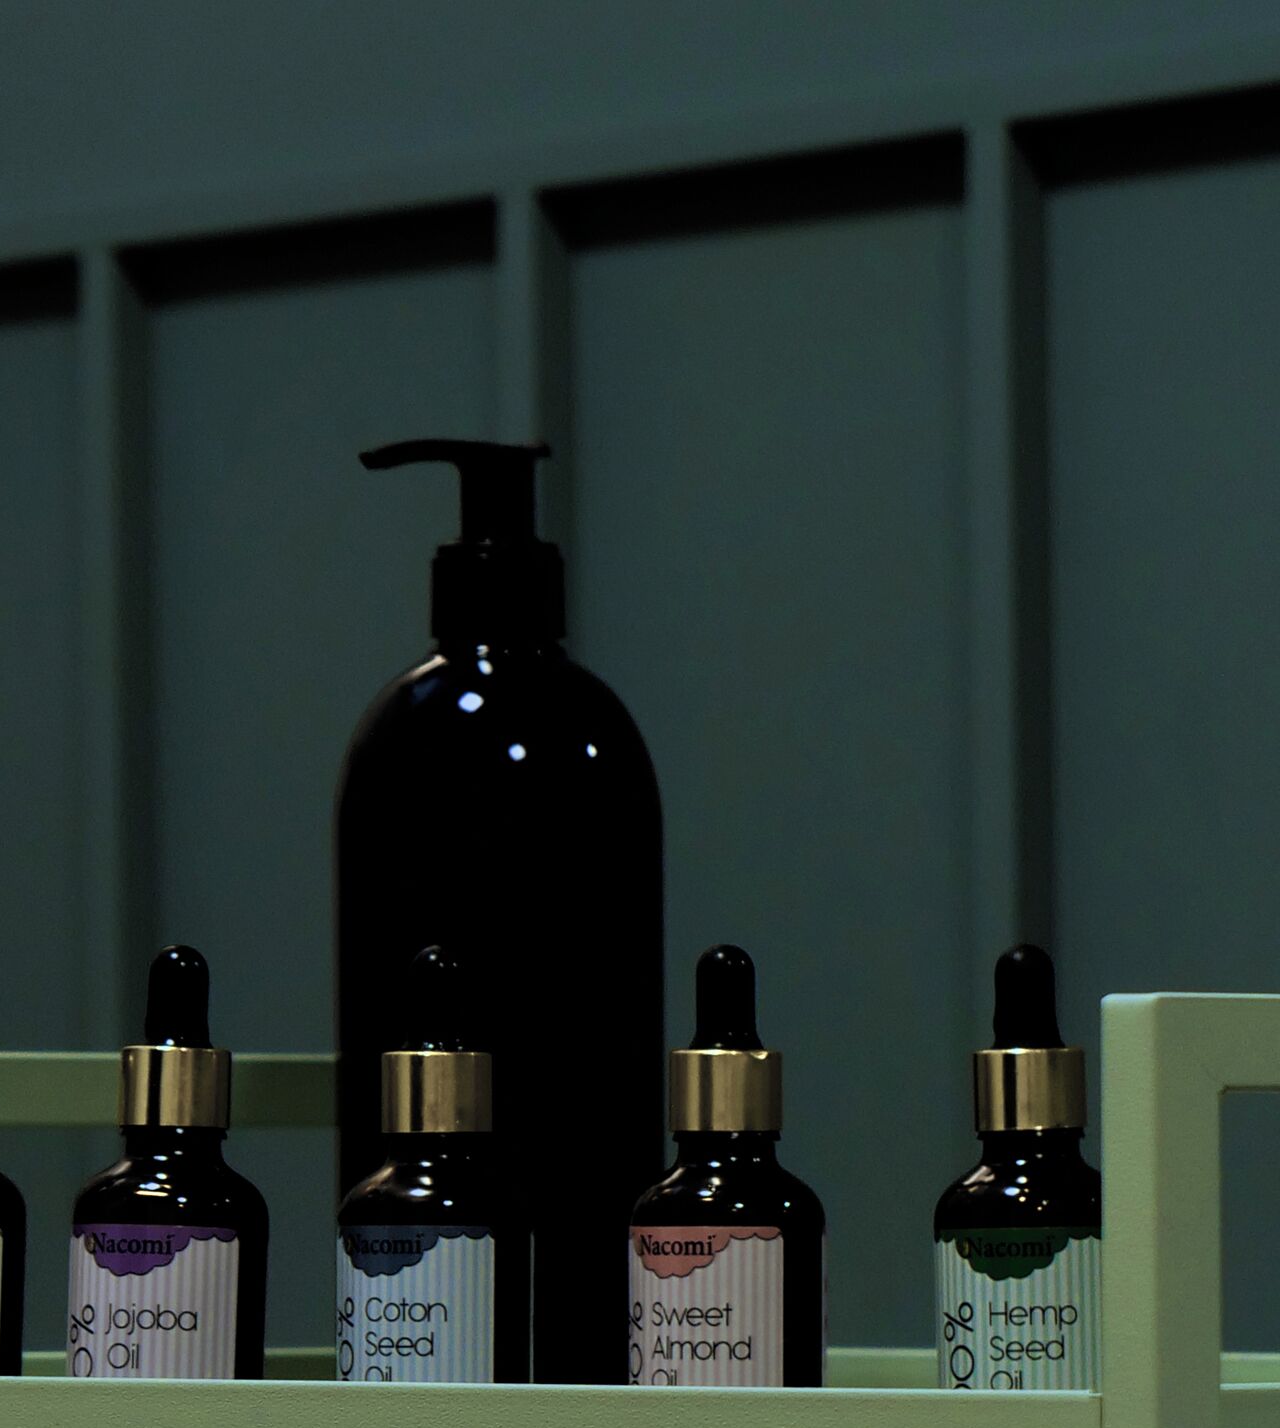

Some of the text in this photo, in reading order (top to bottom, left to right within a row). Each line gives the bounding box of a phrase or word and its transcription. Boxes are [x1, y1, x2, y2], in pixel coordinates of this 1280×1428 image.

[92, 1232, 172, 1256] Nacomi
[639, 1234, 714, 1256] Nacomi
[966, 1236, 1054, 1258] Nacomi
[104, 1303, 198, 1335] Jojoba
[365, 1297, 448, 1322] Coton
[651, 1301, 733, 1327] Sweet
[989, 1301, 1078, 1331] Hemp
[107, 1342, 140, 1369] Oil
[364, 1331, 434, 1357] Seed
[651, 1335, 752, 1361] Almond
[989, 1335, 1065, 1362] Seed
